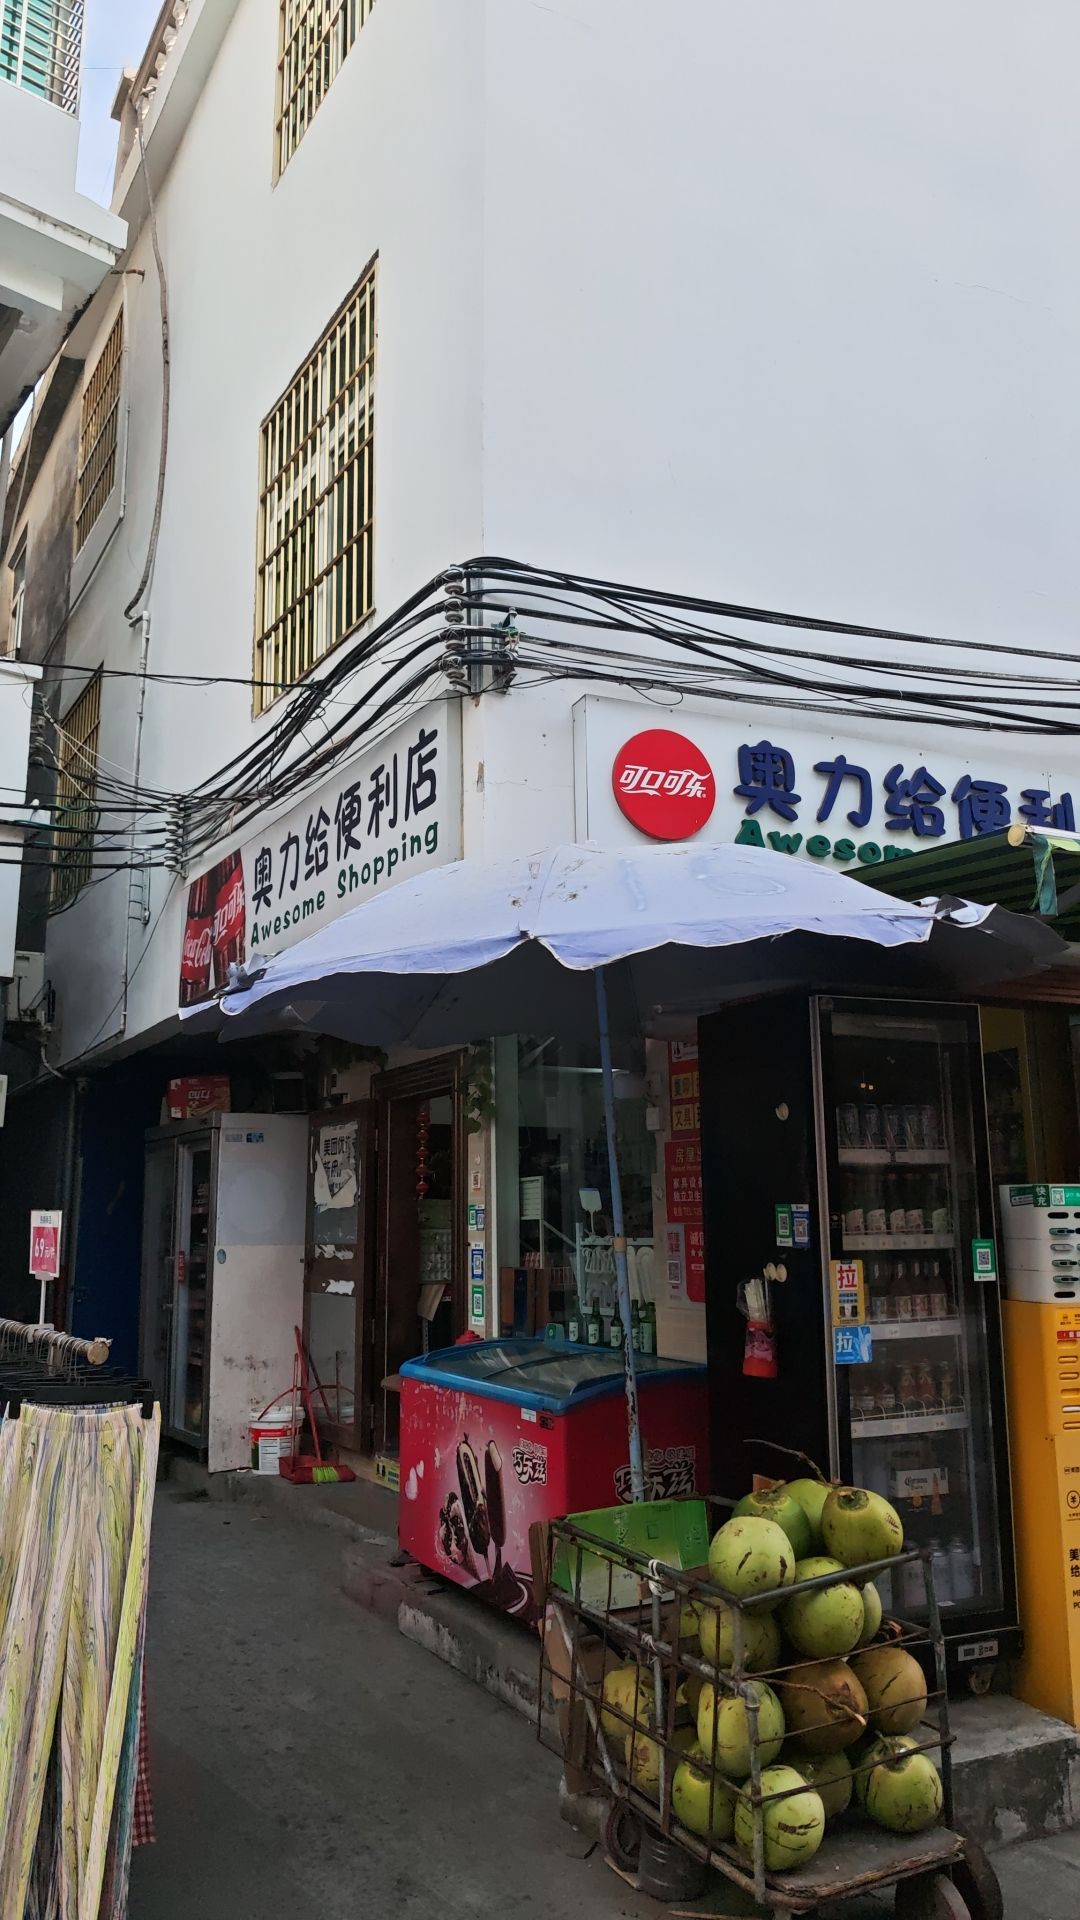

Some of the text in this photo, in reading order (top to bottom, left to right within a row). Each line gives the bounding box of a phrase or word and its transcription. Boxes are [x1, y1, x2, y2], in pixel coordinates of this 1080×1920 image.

[619, 764, 711, 798] 可口可乐
[733, 740, 1076, 840] 奥力给便利
[251, 728, 438, 915] 奥力给便利店
[250, 821, 439, 948] Awesome Shopping
[838, 1265, 858, 1289] 拉
[836, 1331, 853, 1353] 拉
